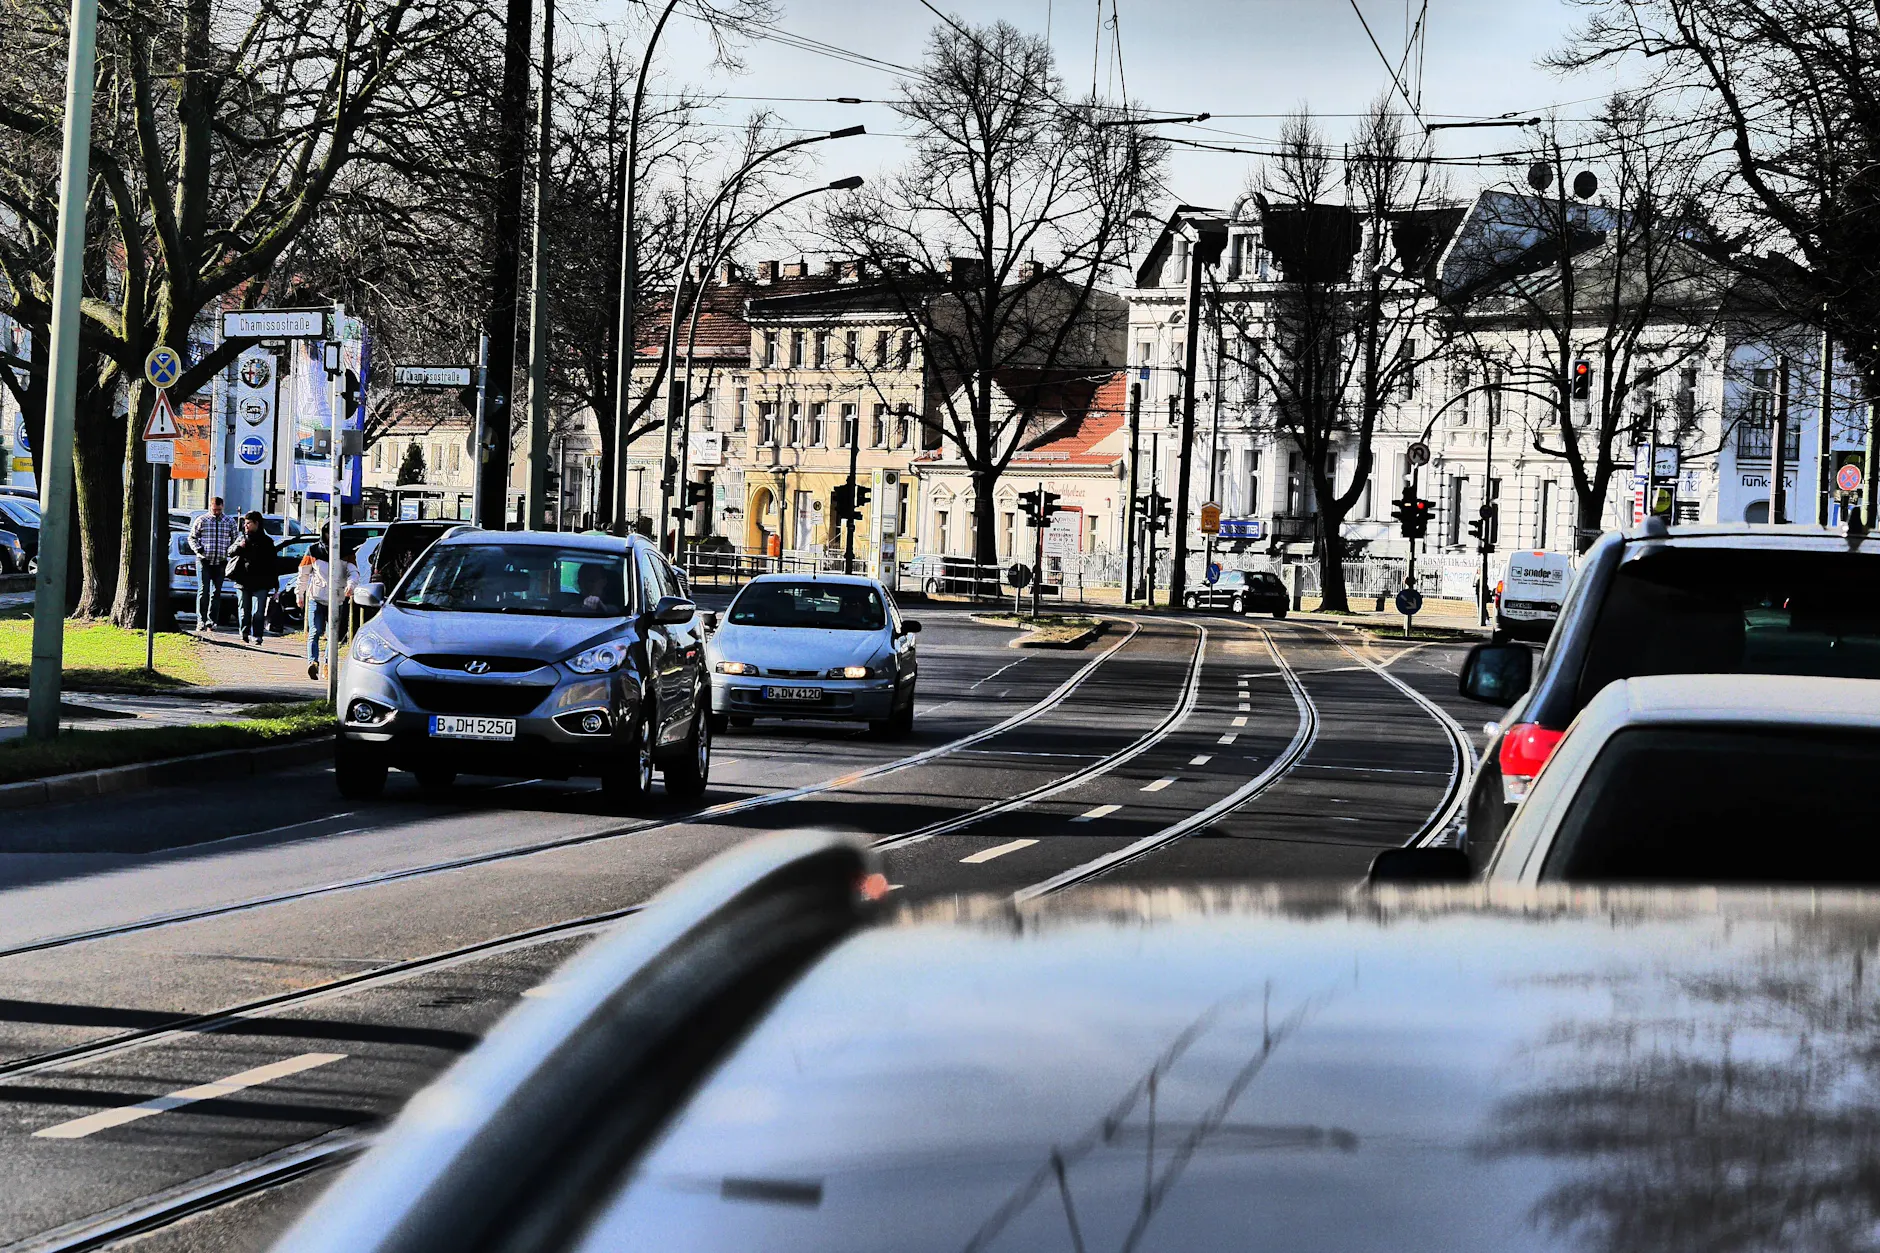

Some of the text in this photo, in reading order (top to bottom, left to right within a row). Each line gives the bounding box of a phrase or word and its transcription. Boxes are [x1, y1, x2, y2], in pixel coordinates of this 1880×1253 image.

[240, 317, 310, 331] Chamissostraße
[241, 444, 262, 455] FIAT
[437, 718, 513, 735] B DH 5250
